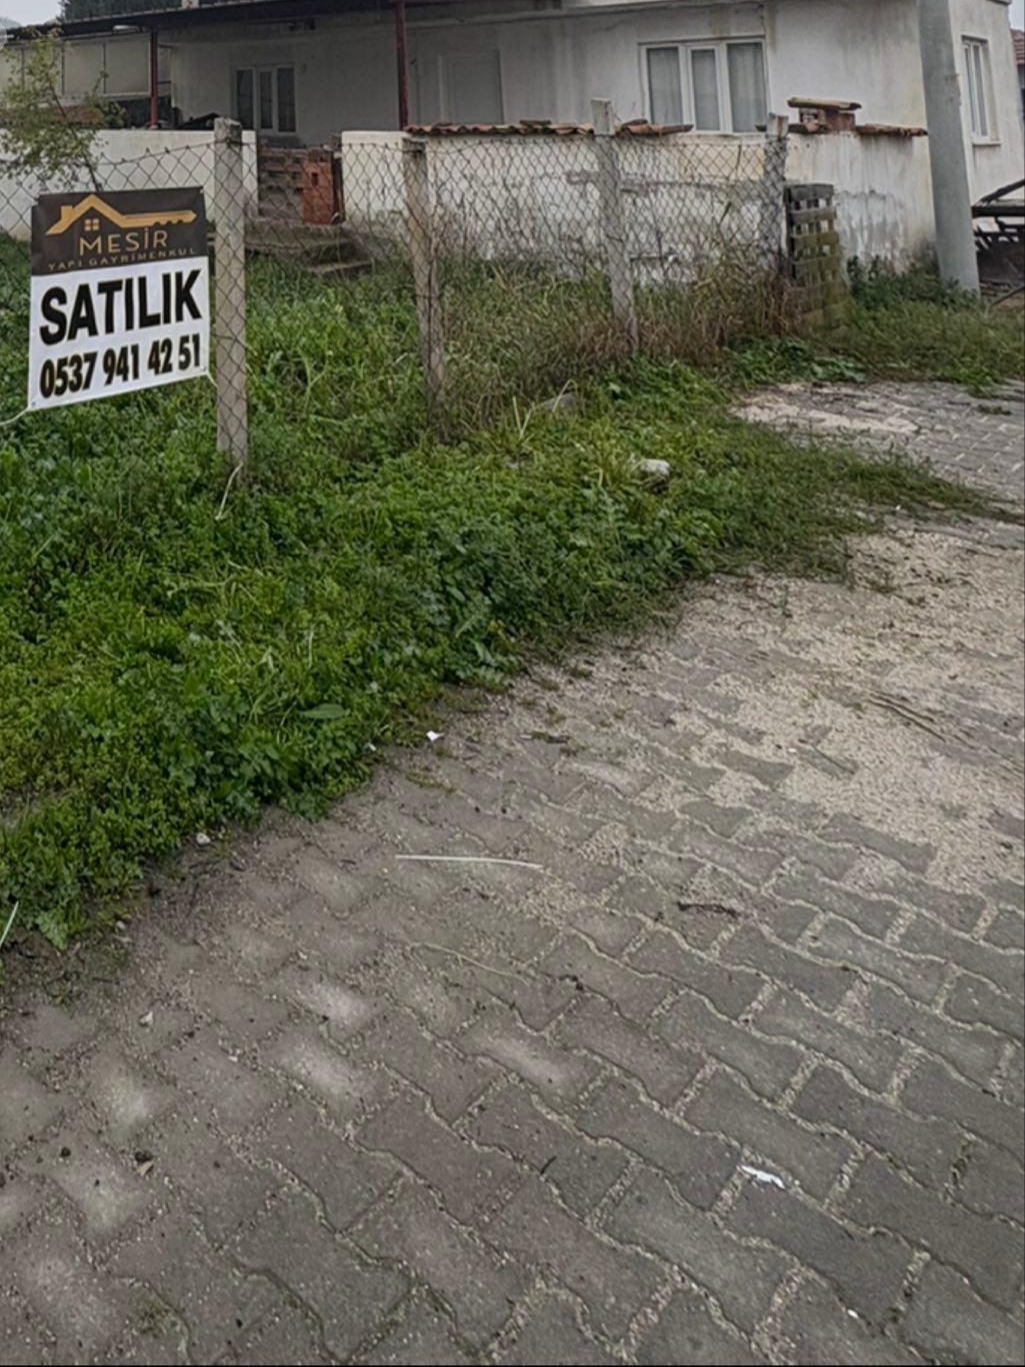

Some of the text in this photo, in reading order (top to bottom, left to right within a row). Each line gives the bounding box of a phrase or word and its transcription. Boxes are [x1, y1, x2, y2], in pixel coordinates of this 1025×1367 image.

[79, 227, 168, 256] MESİR
[48, 260, 82, 271] YAPI
[39, 269, 203, 346] SATILIK
[40, 333, 200, 399] 0537 941 42 51
